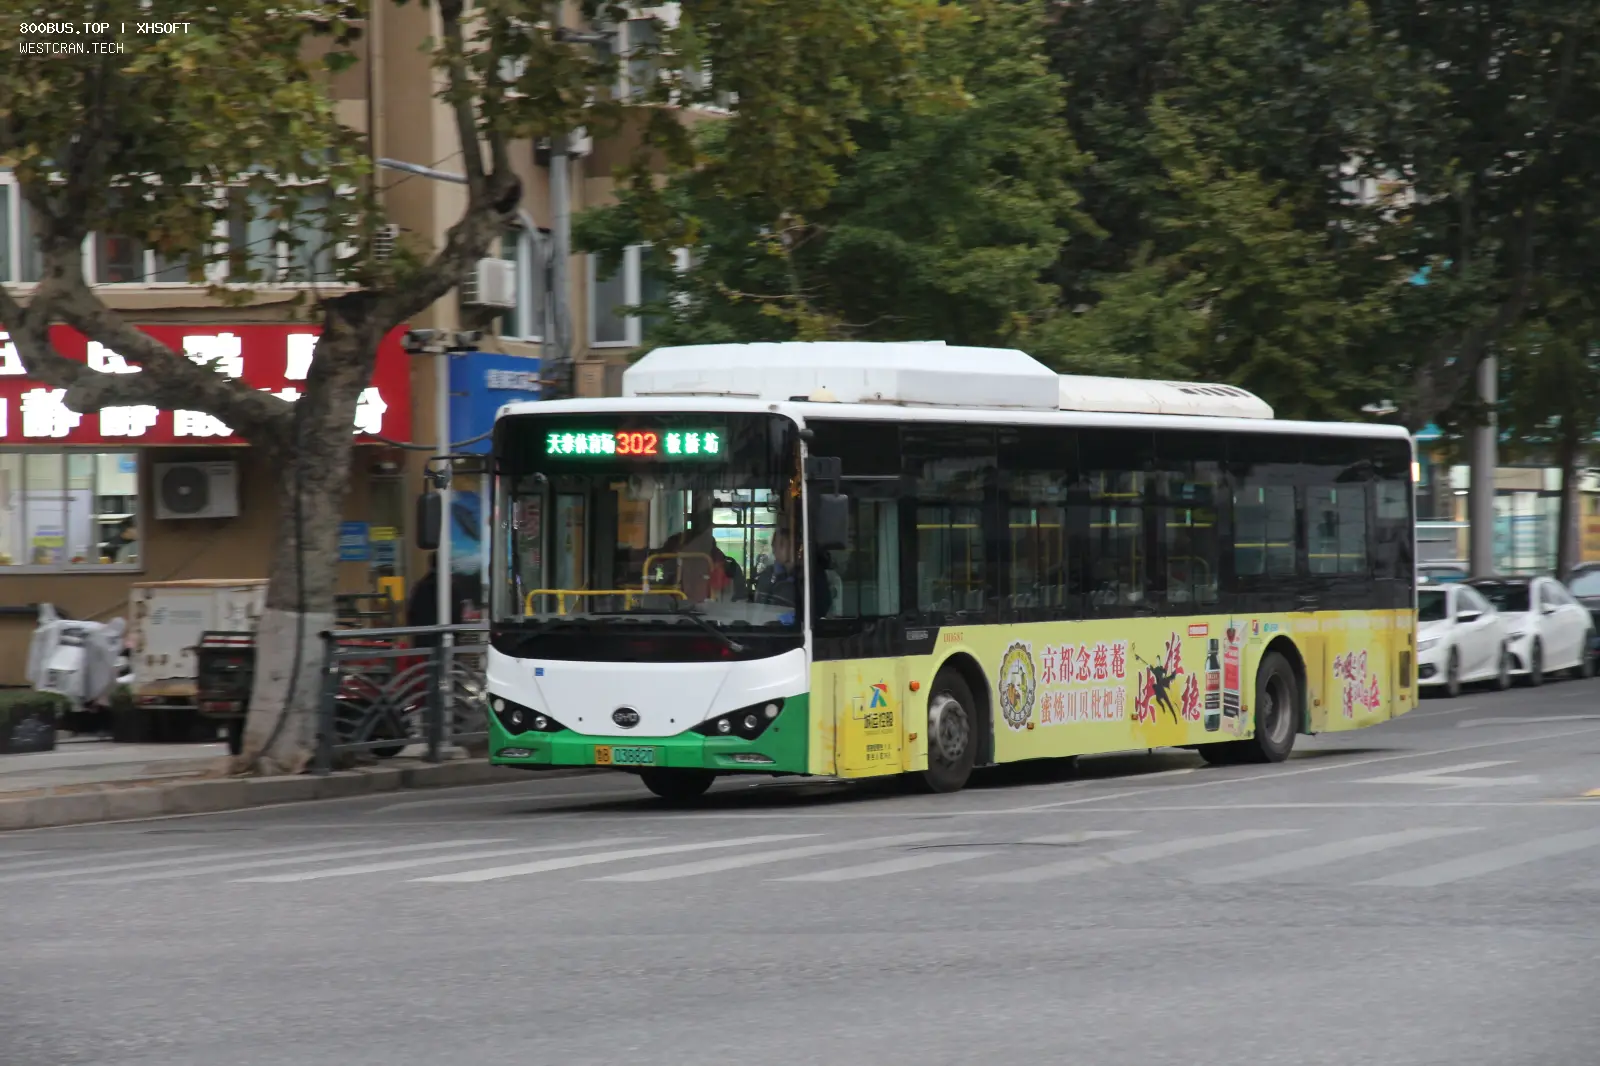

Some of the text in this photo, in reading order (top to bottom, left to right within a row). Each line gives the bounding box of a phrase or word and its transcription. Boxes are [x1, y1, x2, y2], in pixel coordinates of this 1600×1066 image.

[616, 432, 658, 454] 302
[1041, 643, 1125, 685] 京都念慈菴
[1040, 686, 1125, 724] 蜜炼川贝枇杷膏
